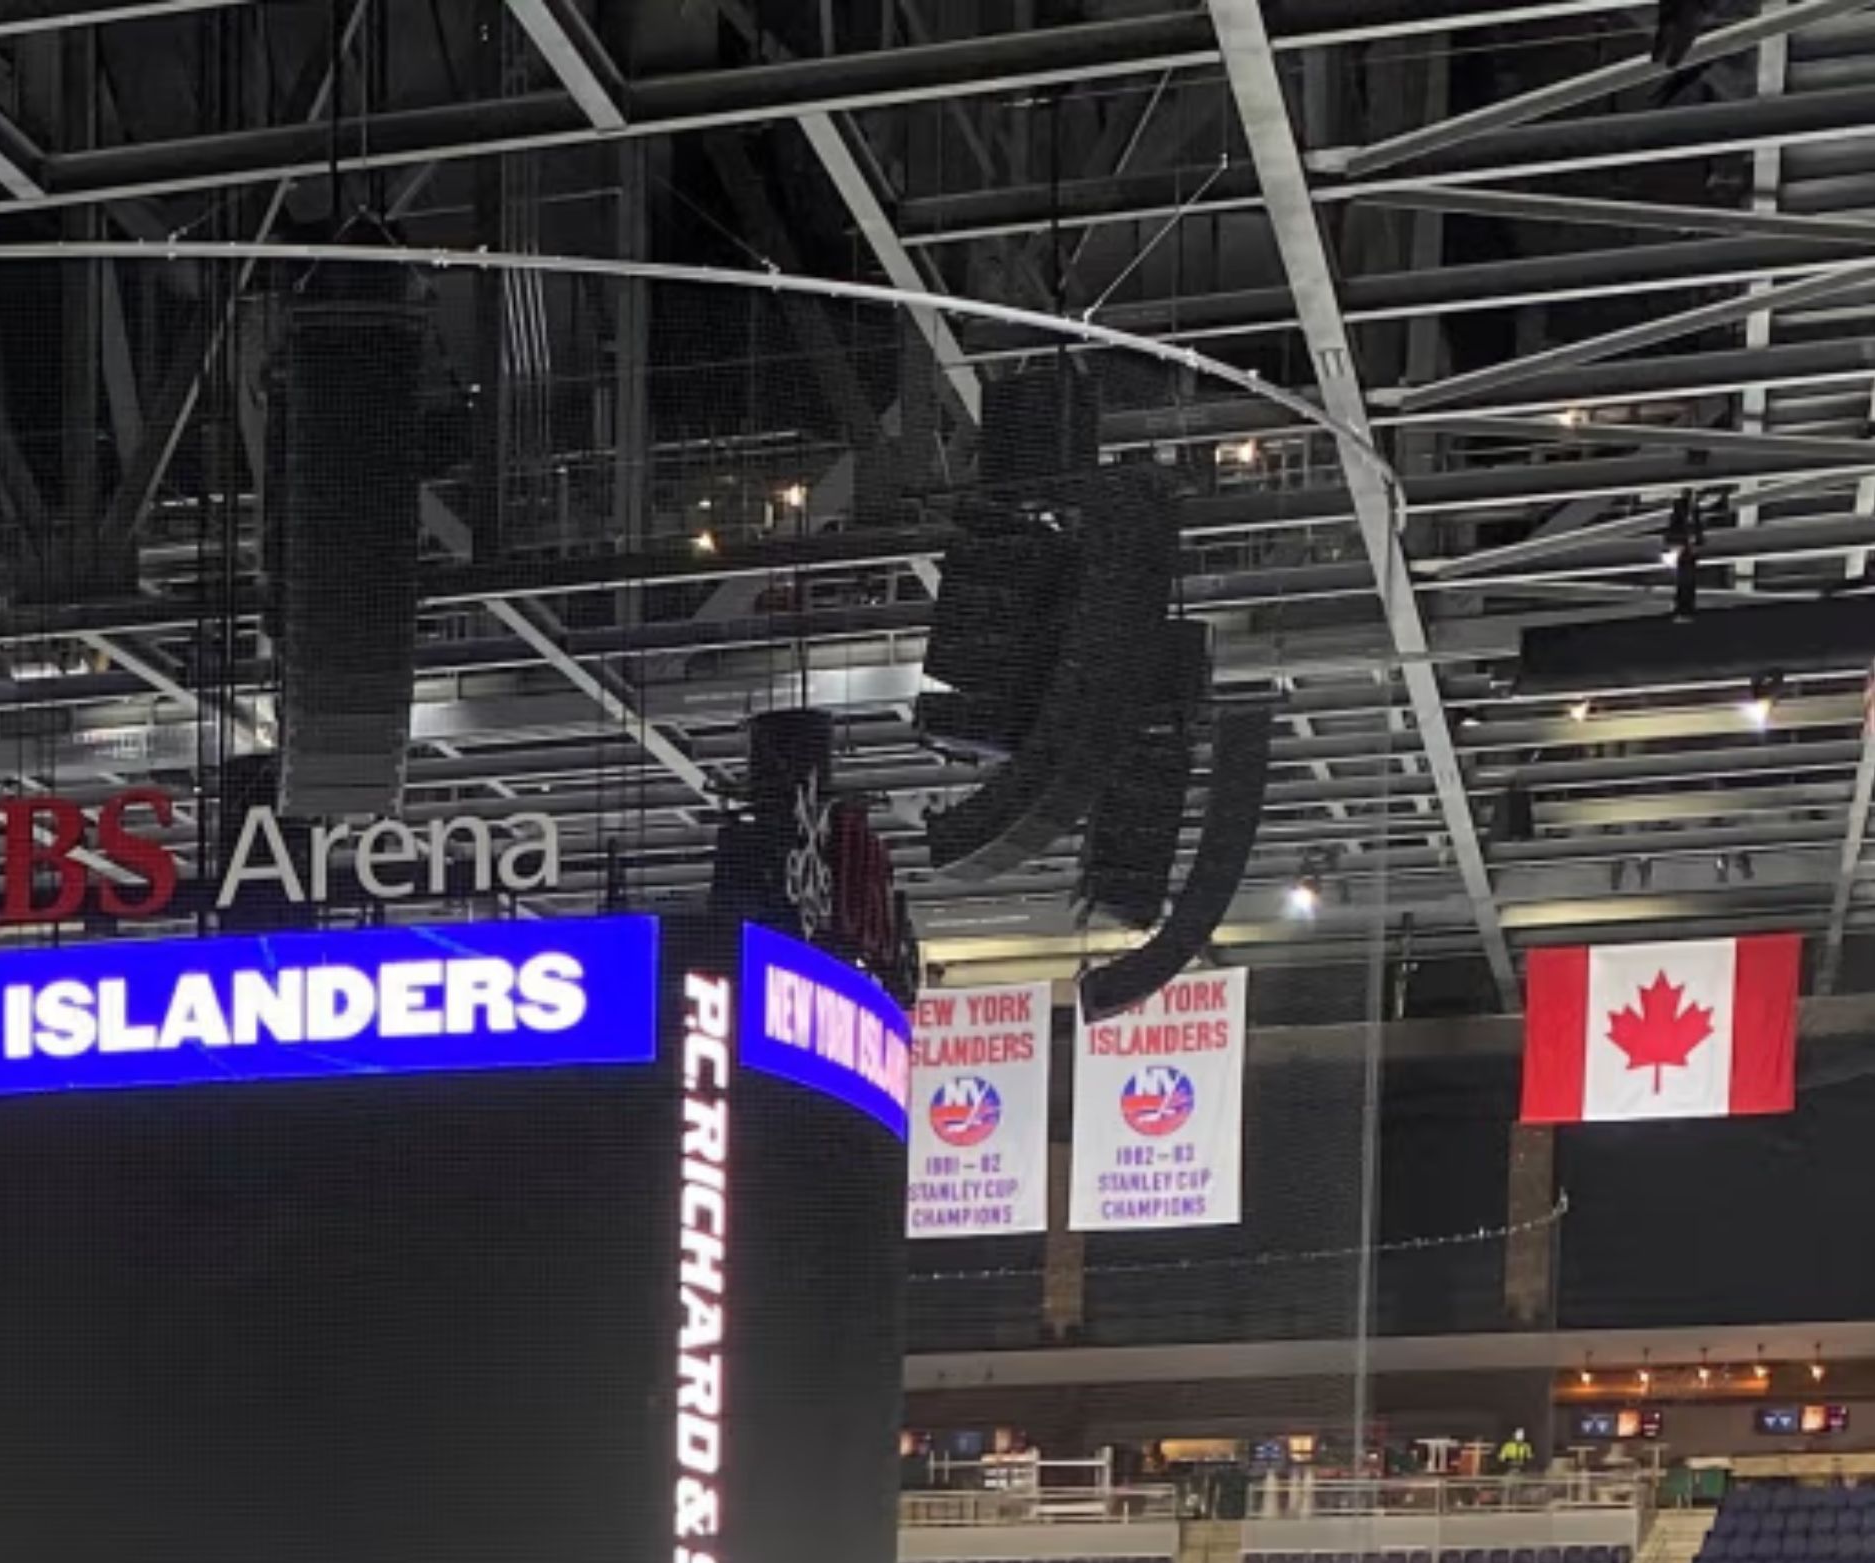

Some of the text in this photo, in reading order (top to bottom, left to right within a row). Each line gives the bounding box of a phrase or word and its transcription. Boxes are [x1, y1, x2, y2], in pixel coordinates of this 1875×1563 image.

[217, 805, 560, 909] Arena
[2, 951, 587, 1059] ISLANDERS
[765, 964, 813, 1050] NEW
[966, 992, 1032, 1026] YORK
[1161, 981, 1228, 1015] YORK
[1090, 1021, 1229, 1055] ISLANDERS
[1098, 1168, 1212, 1192] STANLEY CUP
[912, 1205, 1013, 1229] CHAMPIONS
[1101, 1195, 1206, 1220] CHAMPIONS
[677, 1097, 727, 1474] RICHARD
[675, 1476, 719, 1537] &
